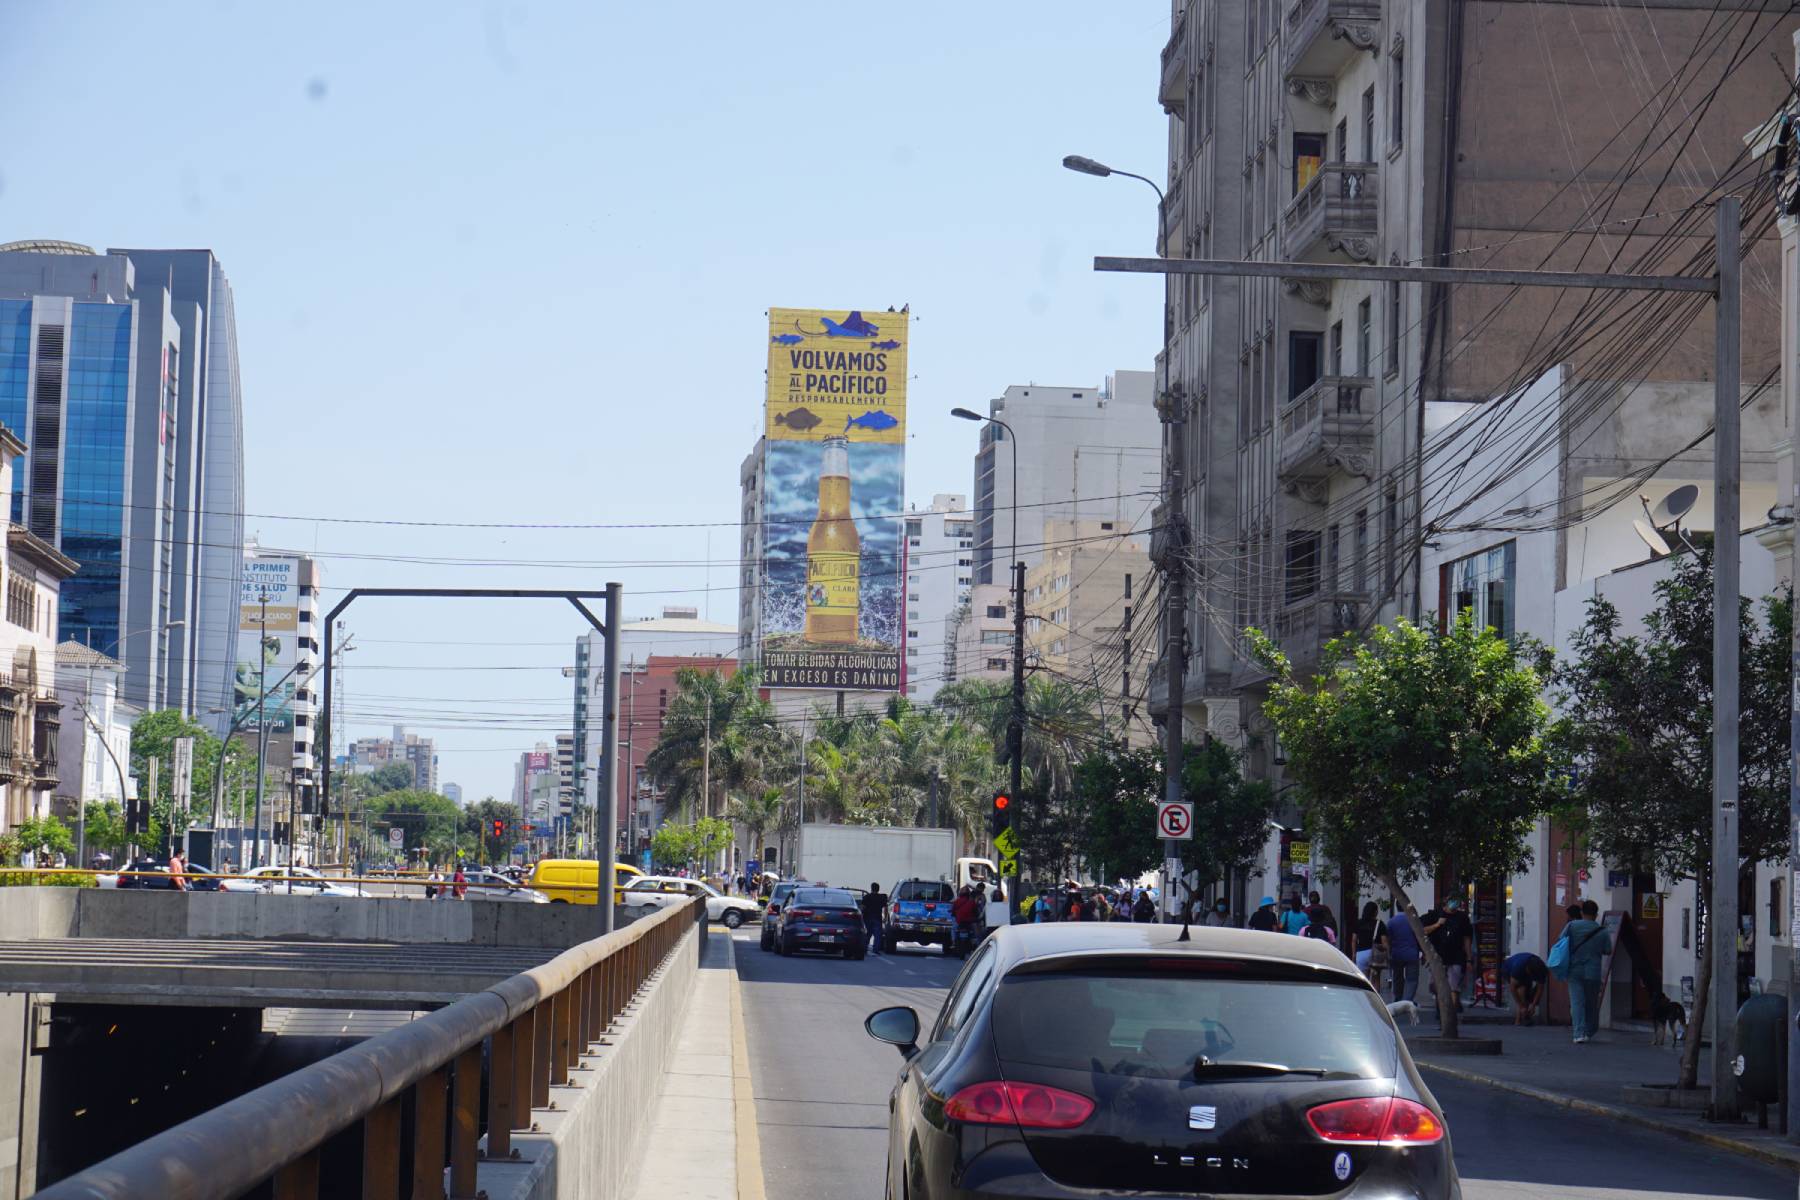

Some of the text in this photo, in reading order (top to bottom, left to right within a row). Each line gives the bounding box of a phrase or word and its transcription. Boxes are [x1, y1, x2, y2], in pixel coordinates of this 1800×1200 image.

[790, 350, 887, 372] VOLVAMOS
[790, 371, 887, 395] AL PACÍFICO
[788, 395, 887, 406] RESPONSABLEMENTE
[253, 563, 290, 572] PRIMER
[241, 573, 287, 582] NSTITUTO
[765, 653, 796, 667] TOMAR
[798, 654, 836, 668] BEBIDAS
[764, 669, 897, 686] EN EXCESO ES DAÑINO
[1153, 1154, 1249, 1169] LEON
